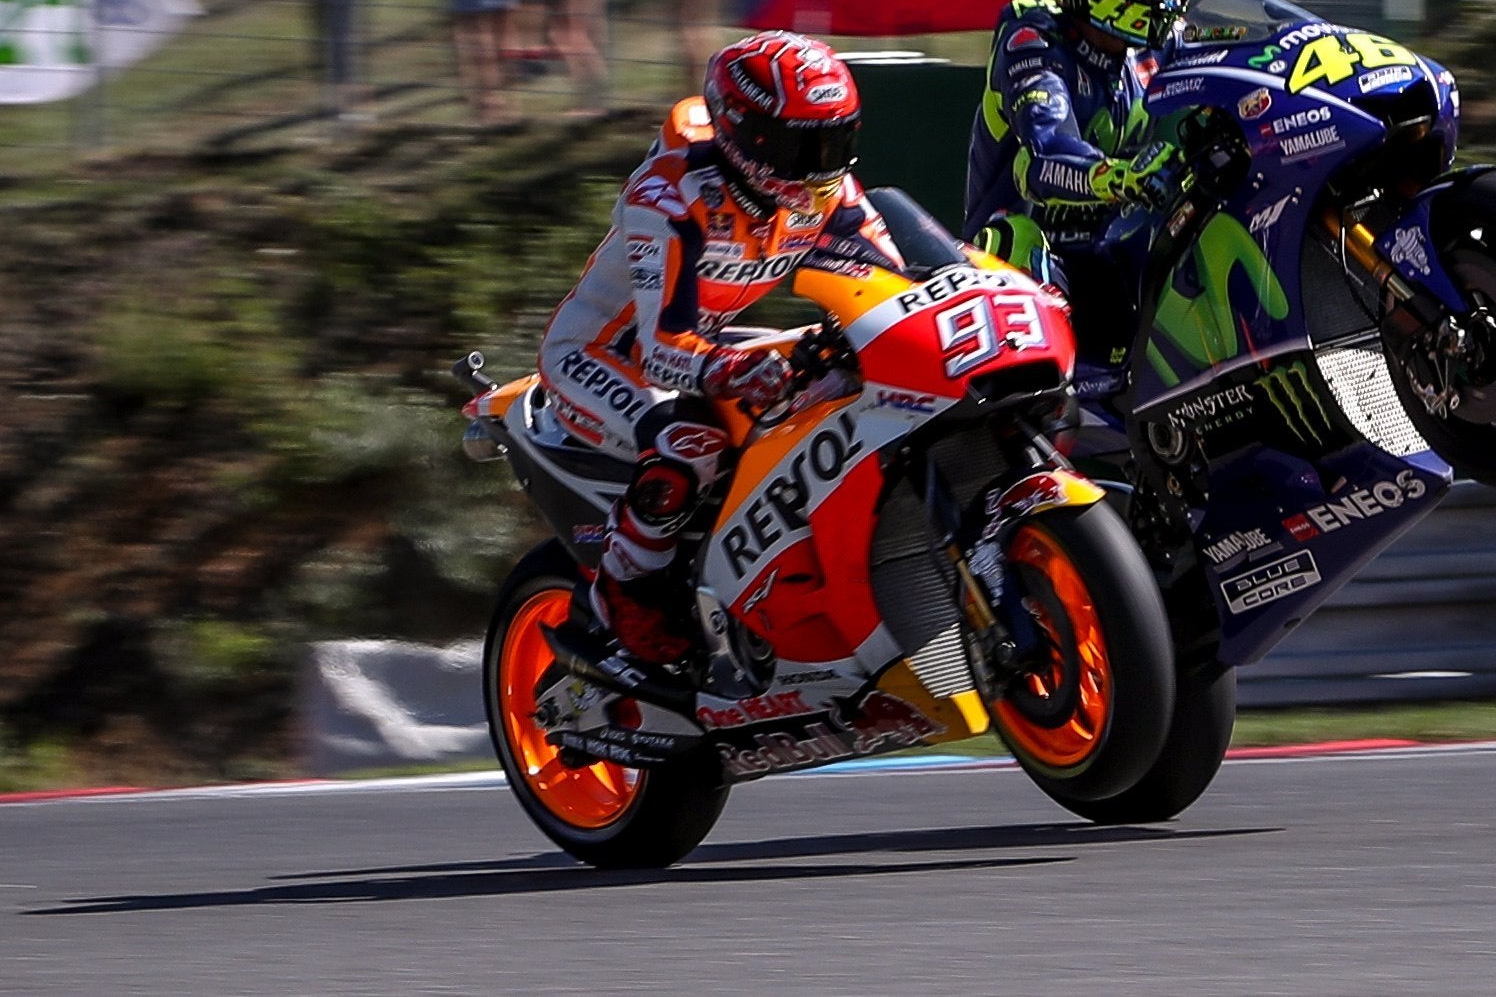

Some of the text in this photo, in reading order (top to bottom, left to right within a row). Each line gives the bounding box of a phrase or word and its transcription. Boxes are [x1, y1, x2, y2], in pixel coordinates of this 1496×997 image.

[1288, 31, 1417, 94] 46
[1272, 106, 1332, 134] ENEOS
[1279, 124, 1340, 156] YAMALUBE
[936, 294, 1049, 379] 93
[556, 350, 648, 424] REPSOL
[1167, 383, 1254, 429] MONSTER
[1195, 407, 1254, 435] ENERGY
[720, 412, 864, 581] REPSOL
[1307, 469, 1426, 533] ENEOS
[1236, 558, 1300, 591] BLUE
[1242, 574, 1307, 607] CORE
